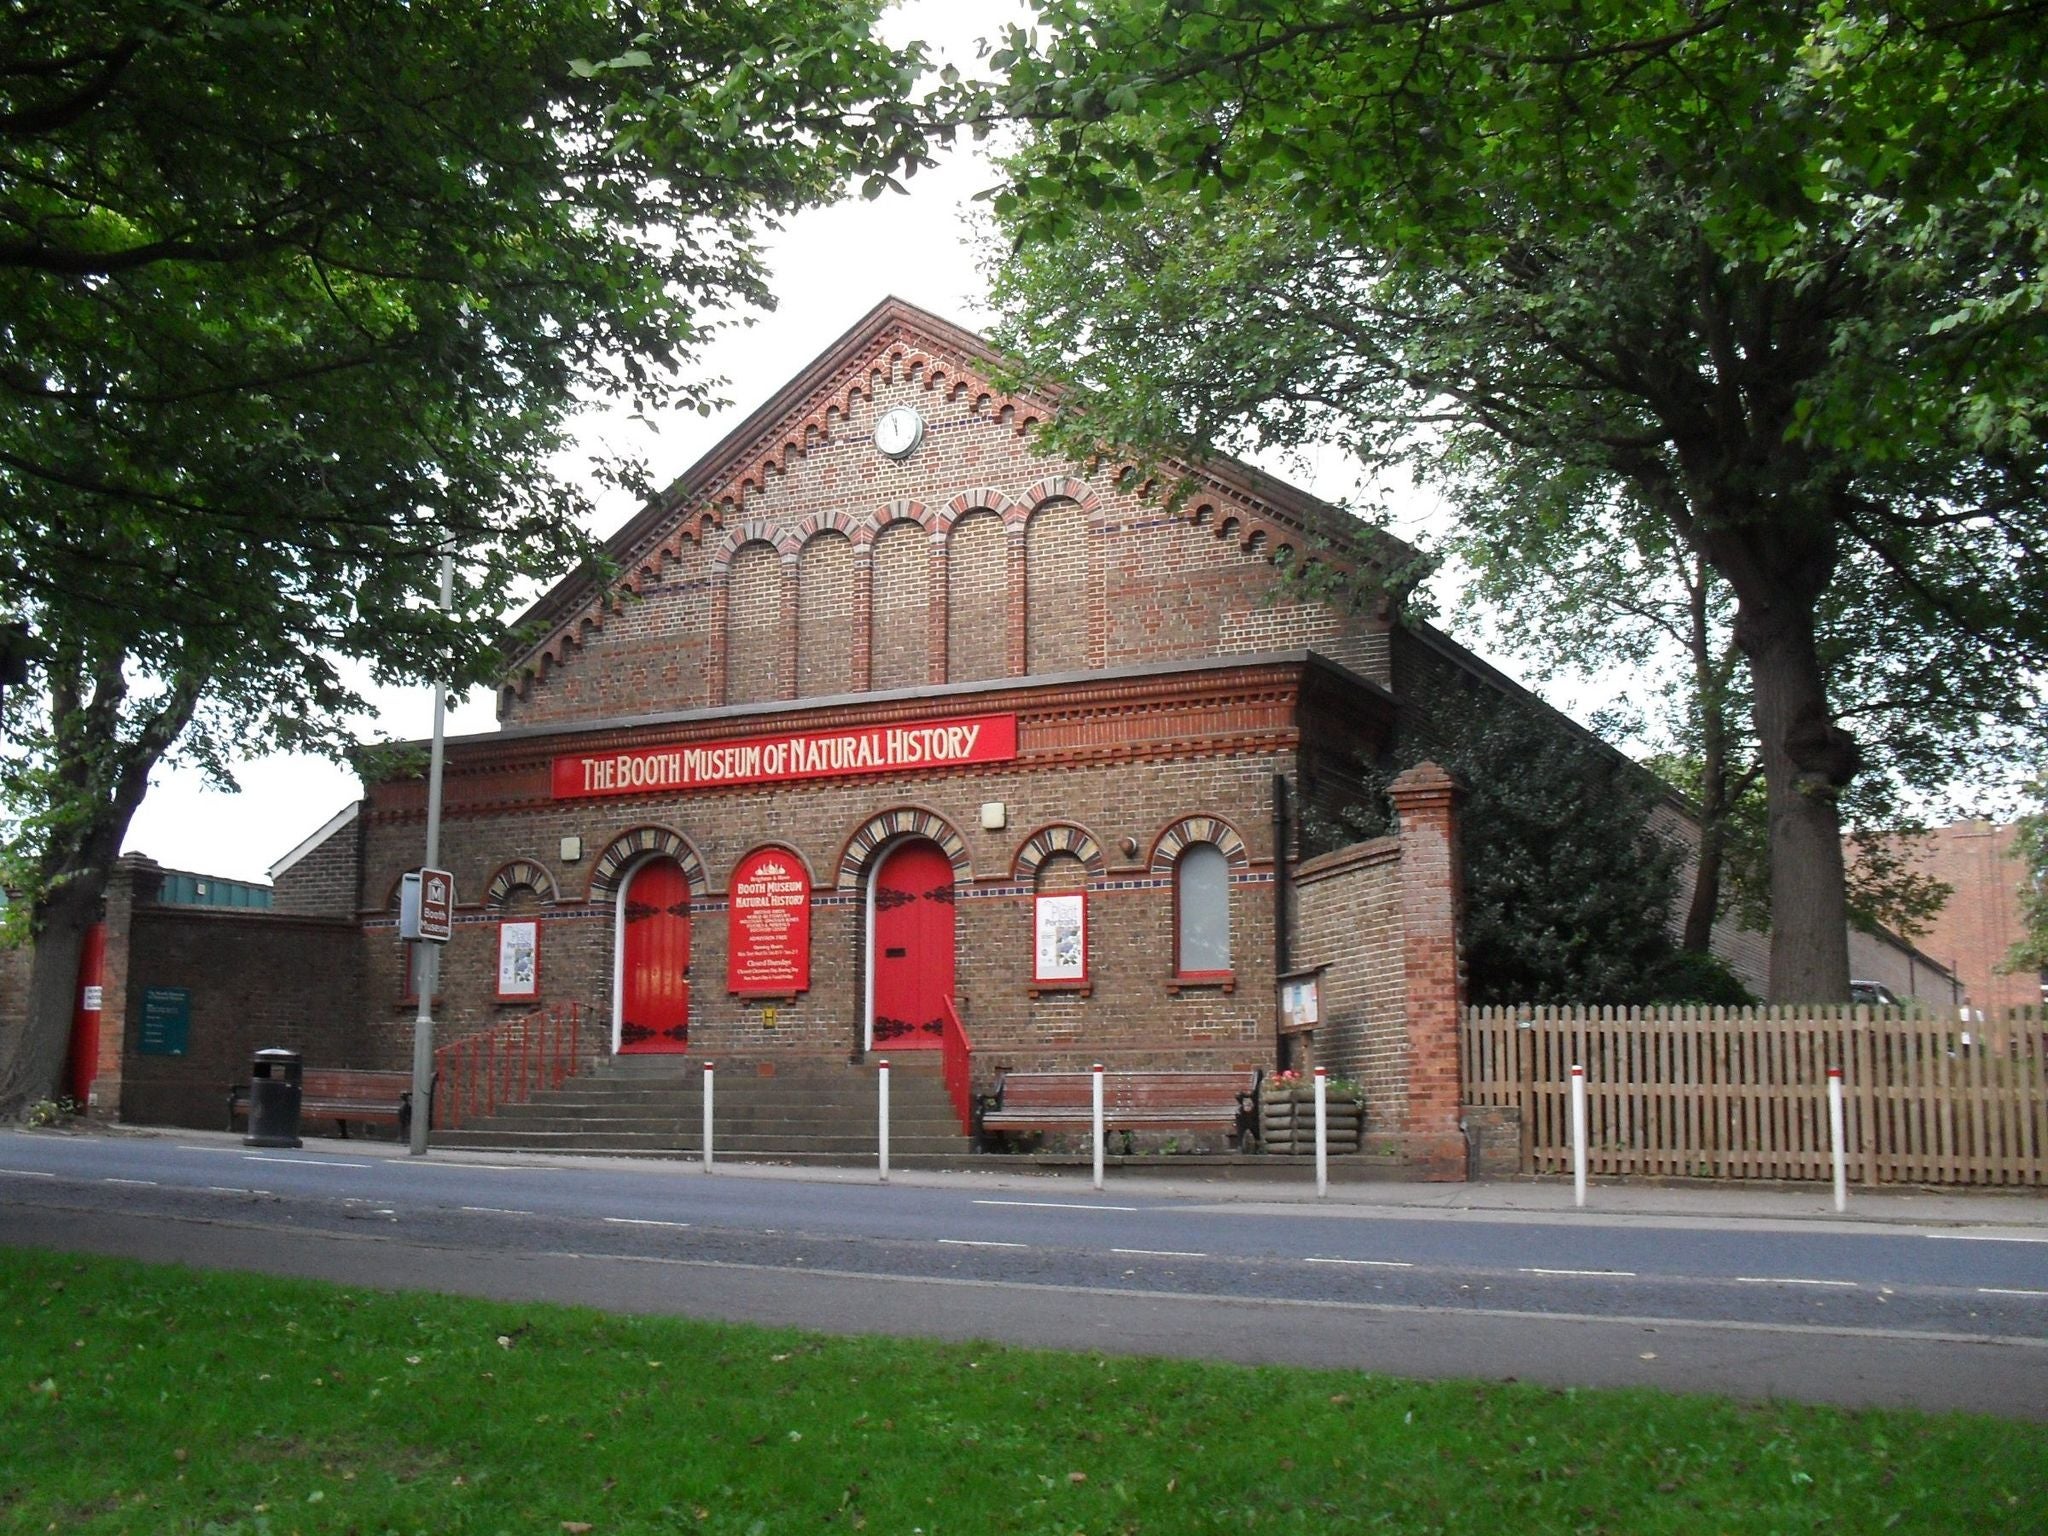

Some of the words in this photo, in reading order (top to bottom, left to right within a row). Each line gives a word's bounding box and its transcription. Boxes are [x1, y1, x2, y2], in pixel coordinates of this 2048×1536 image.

[582, 758, 616, 791] THE
[617, 753, 681, 788] BOOTH
[683, 745, 761, 783] MUSEUM
[763, 742, 788, 775] OF
[790, 734, 885, 774] NATURAL
[886, 724, 980, 765] HISTORY
[737, 883, 766, 895] BOOTH
[767, 881, 802, 892] MUSEUM
[735, 896, 770, 908] NATURAL
[771, 895, 805, 906] HISTORY
[424, 907, 447, 920] Booth
